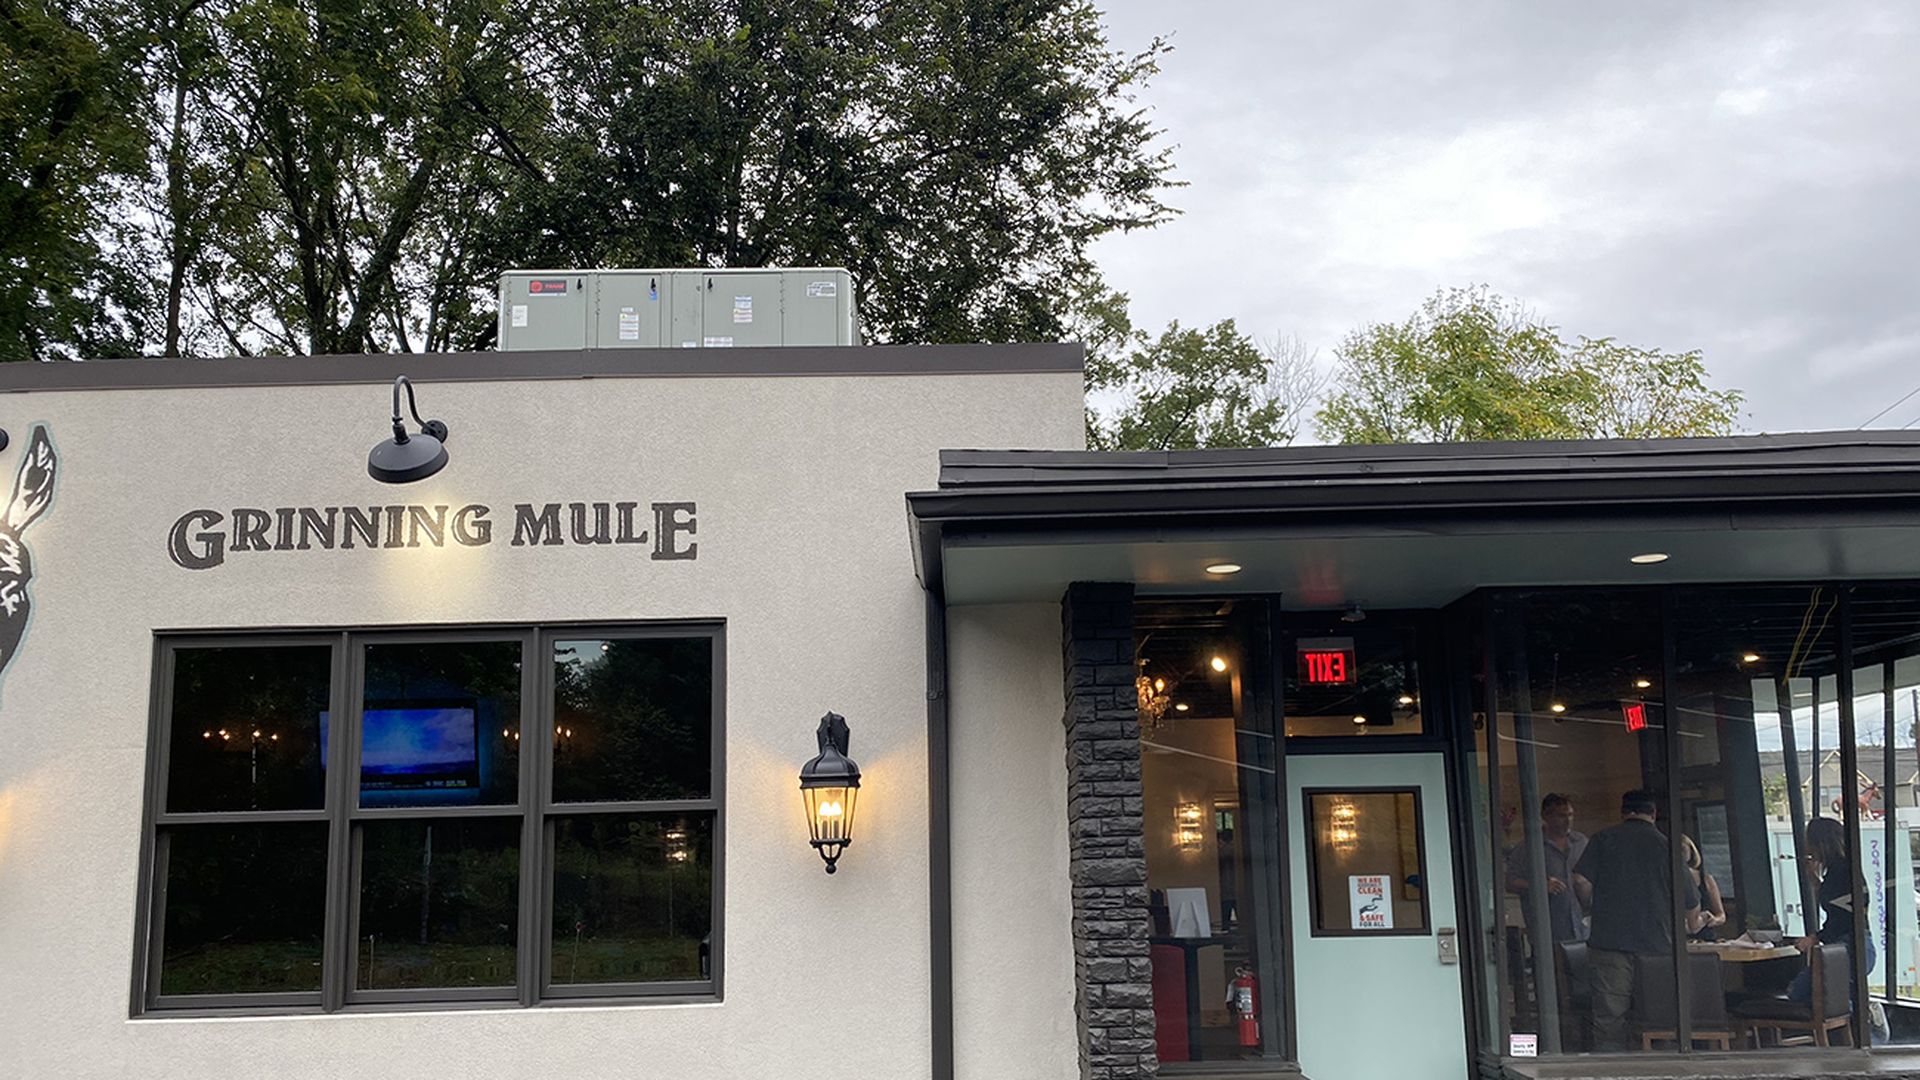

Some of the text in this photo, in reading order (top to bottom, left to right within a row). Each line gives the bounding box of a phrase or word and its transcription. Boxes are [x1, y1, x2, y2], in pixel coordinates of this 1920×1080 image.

[167, 501, 698, 570] GRINNING MULE
[1358, 887, 1383, 895] CLEAN
